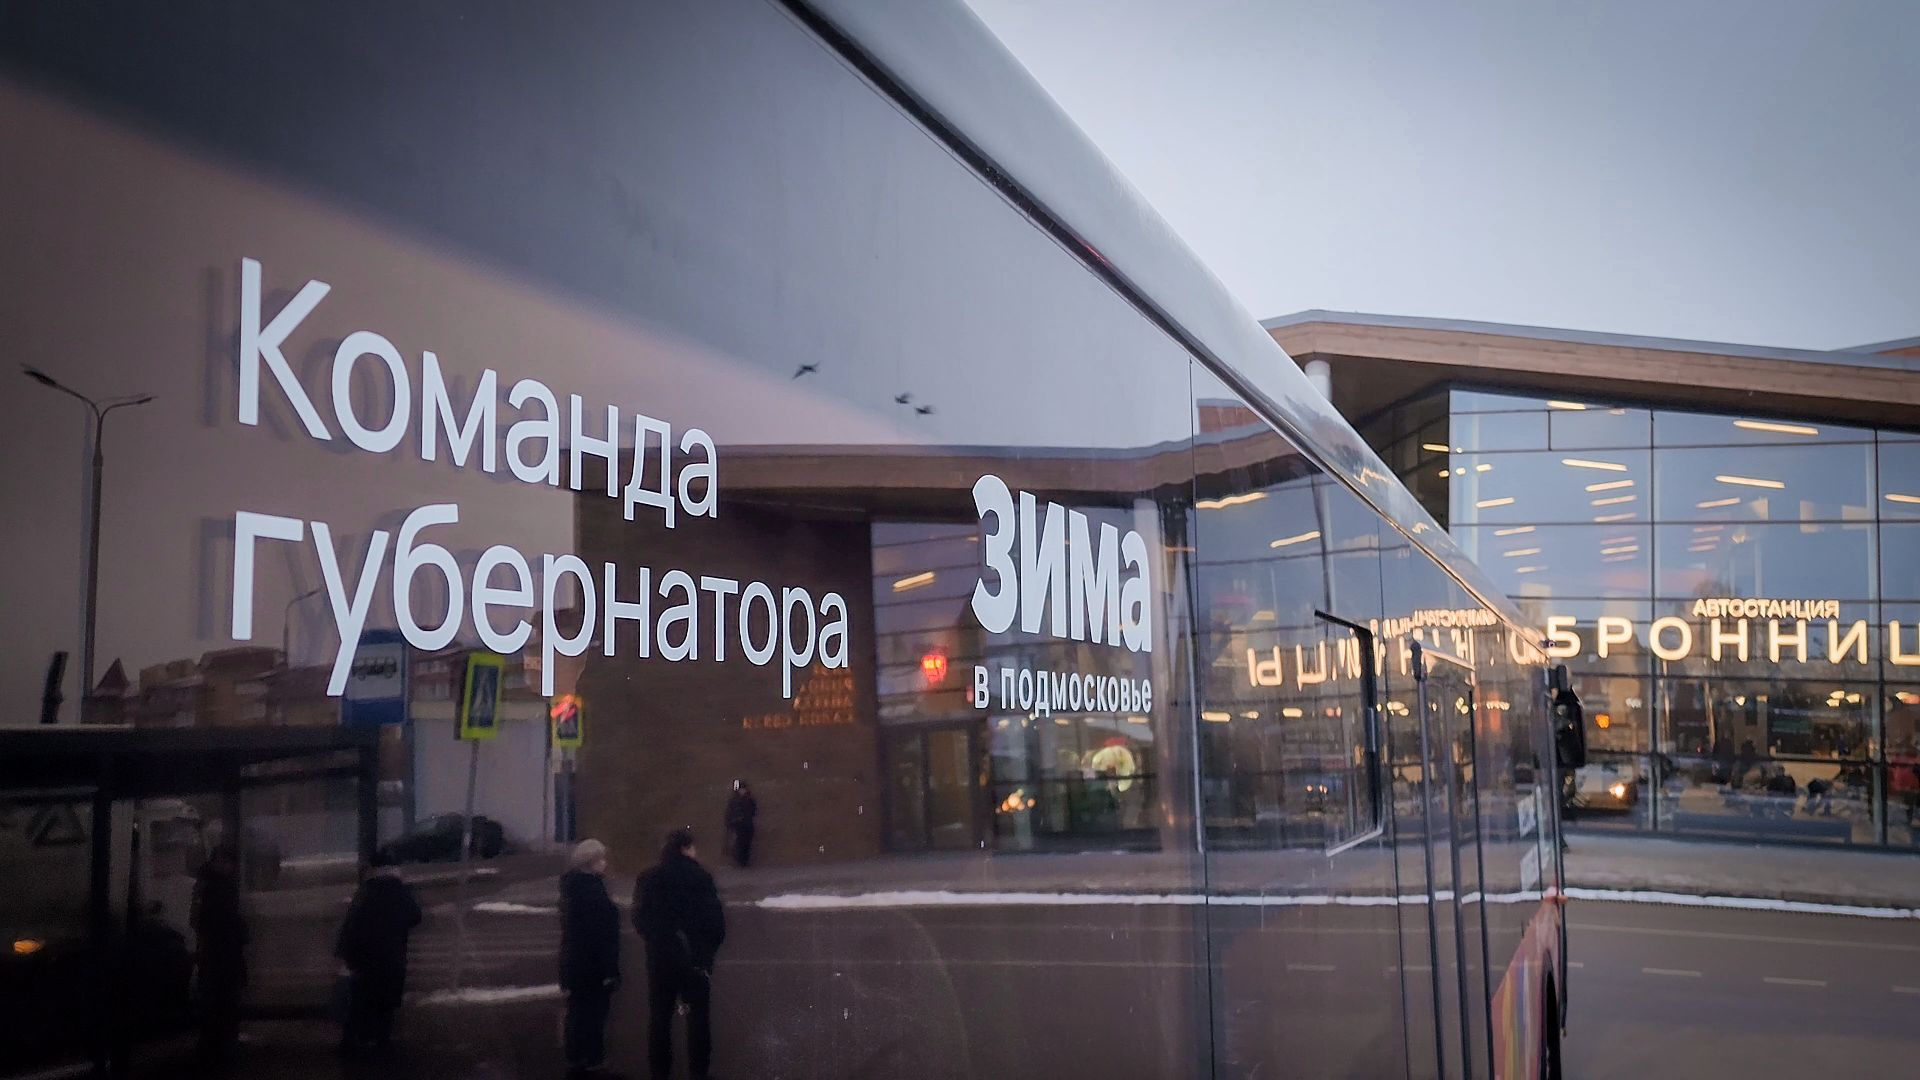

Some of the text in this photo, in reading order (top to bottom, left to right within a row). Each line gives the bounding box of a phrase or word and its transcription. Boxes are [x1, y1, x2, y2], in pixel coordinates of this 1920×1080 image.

[238, 257, 719, 529] Команда
[231, 503, 849, 700] губернатора
[1546, 615, 1920, 665] БРОННИЦ
[1692, 598, 1840, 622] АВТОСТАНЦИЯ
